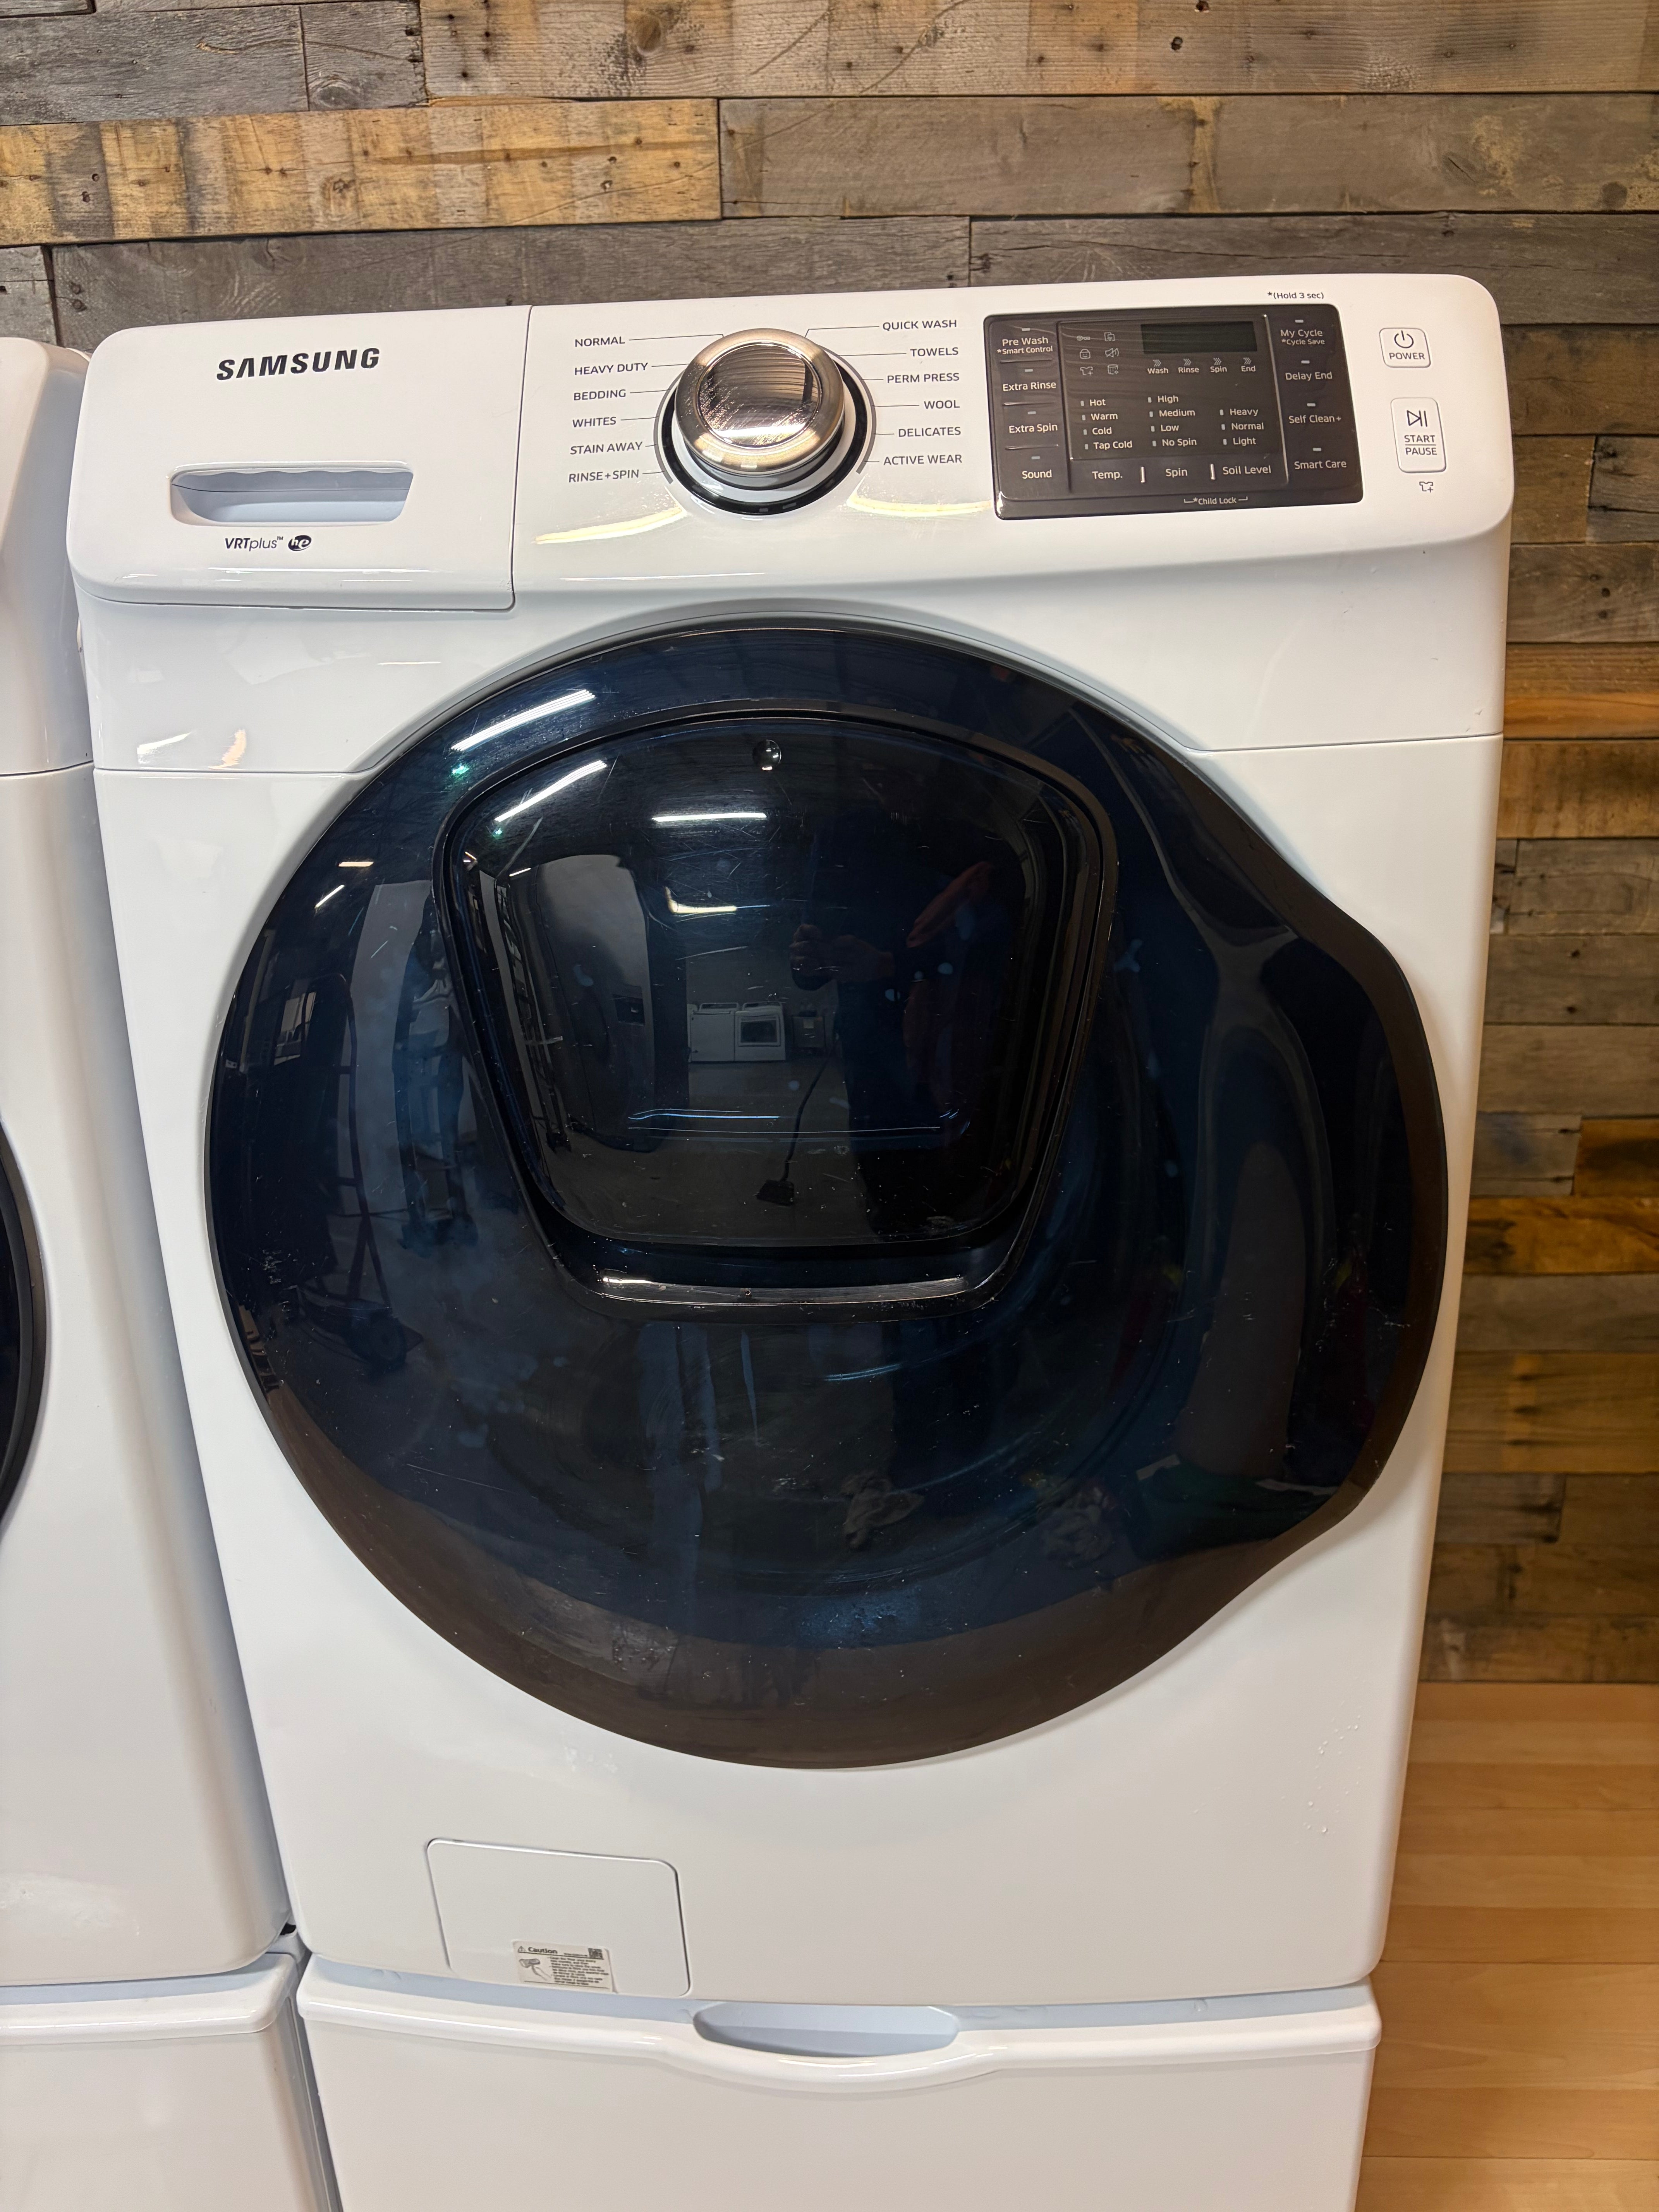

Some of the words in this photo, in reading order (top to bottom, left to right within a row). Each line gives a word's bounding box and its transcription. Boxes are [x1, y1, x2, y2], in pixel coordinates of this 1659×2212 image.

[883, 321, 919, 331] QUICK
[922, 319, 957, 328] WASH
[1280, 329, 1295, 338] My
[1298, 329, 1323, 338] Cycle
[575, 336, 625, 347] NORMAL
[1021, 336, 1048, 345] Wash
[910, 347, 958, 357] TOWELS
[216, 348, 380, 381] SAMSUNG
[575, 364, 614, 375] HEAVY
[617, 362, 648, 372] DUTY
[887, 374, 920, 383] PERM
[924, 373, 960, 382] PRESS
[1285, 372, 1312, 381] Delay
[1315, 371, 1333, 380] End
[1003, 383, 1028, 392] Extra
[1030, 381, 1056, 390] Rinse
[574, 389, 626, 401] BEDDING
[1158, 395, 1179, 404] High
[924, 400, 960, 409] WOOL
[1159, 409, 1195, 417] Medium
[1230, 408, 1258, 417] Heavy
[572, 416, 617, 428] WHITES
[1288, 415, 1306, 424] Self
[898, 426, 961, 437] DELICATES
[1009, 425, 1034, 433] Extra
[1037, 423, 1058, 433] Spin
[1092, 427, 1112, 435] Cold
[1093, 442, 1110, 450] Tap
[1113, 440, 1133, 448] Cold
[1177, 438, 1197, 447] Spin
[1233, 437, 1256, 446] Light
[570, 444, 604, 455] STAIN
[606, 441, 643, 452] AWAY
[1405, 447, 1437, 455] PAUSE
[883, 455, 924, 465] ACTIVE
[927, 454, 962, 464] WEAR
[1294, 460, 1323, 469] Smart
[1325, 460, 1347, 468] Care
[1022, 469, 1052, 479] Sound
[1165, 468, 1188, 478] Spin
[1223, 466, 1241, 475] Soil
[1244, 465, 1271, 474] Level
[1092, 471, 1123, 480] Temp.
